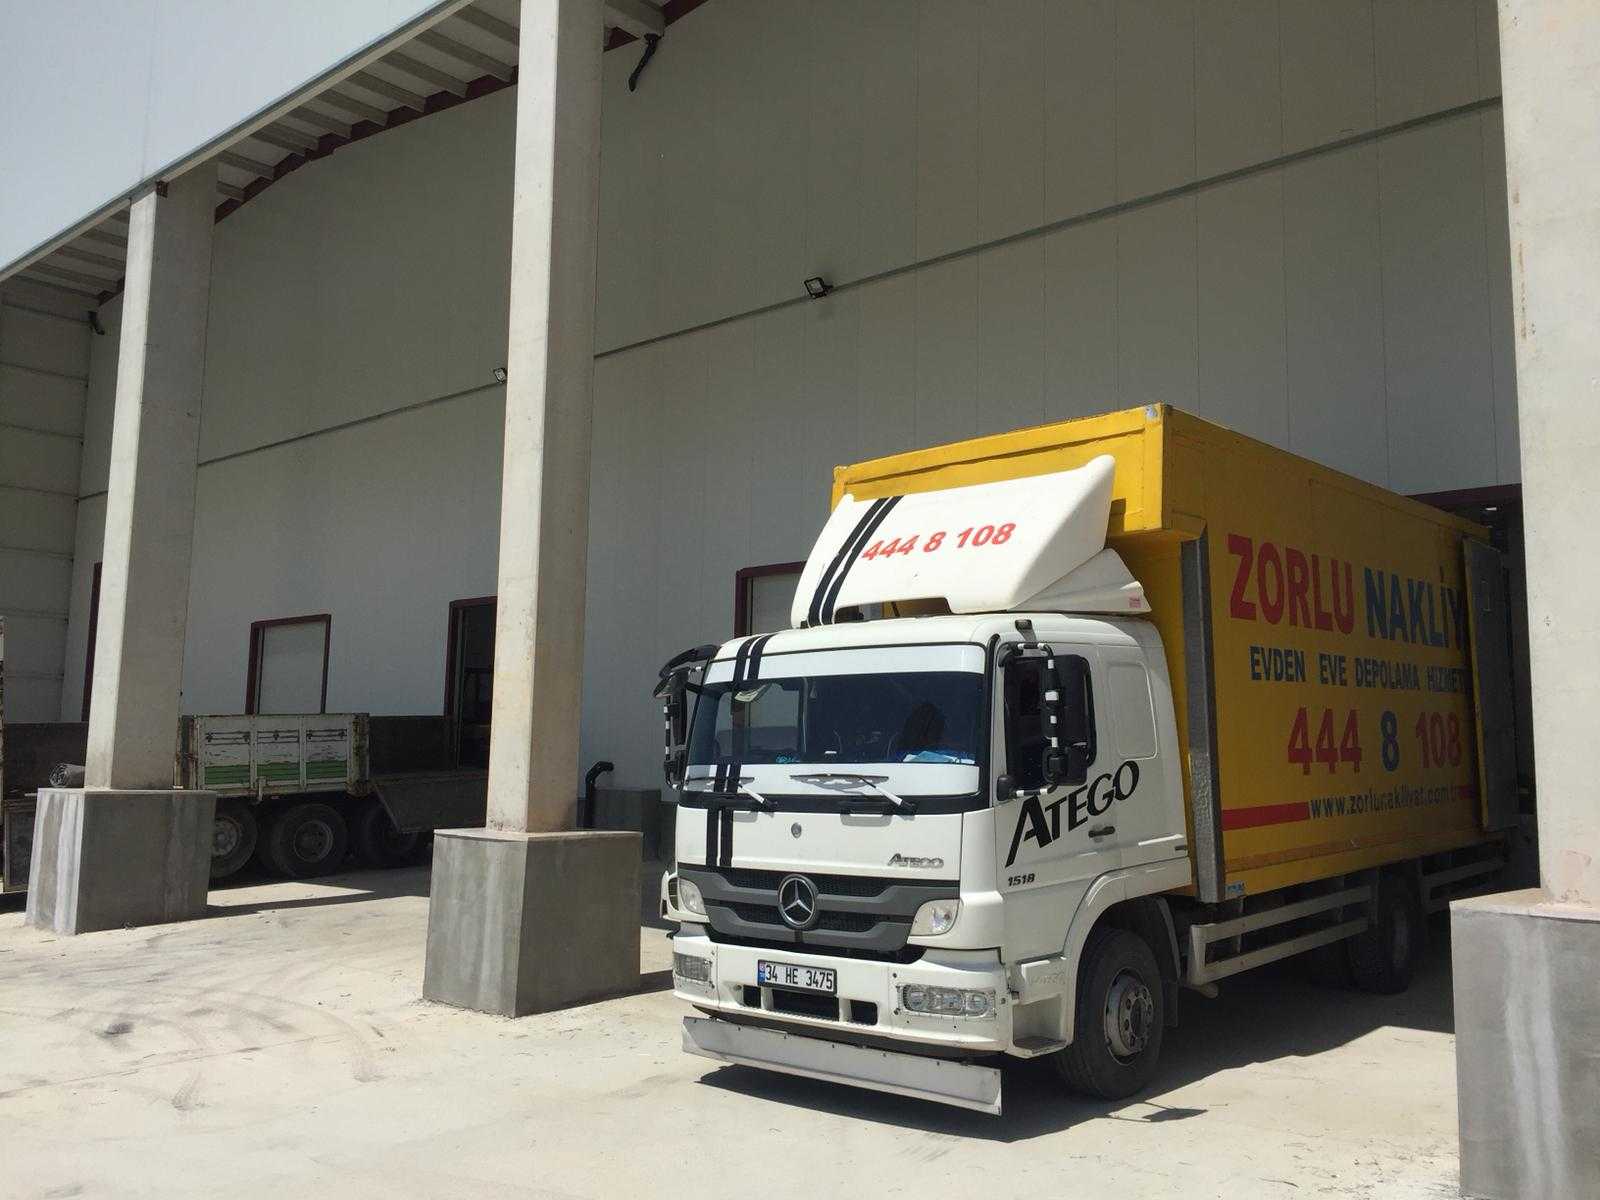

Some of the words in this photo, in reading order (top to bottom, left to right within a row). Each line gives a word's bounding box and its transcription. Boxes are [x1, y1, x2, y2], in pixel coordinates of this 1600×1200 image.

[862, 535, 920, 560] 444
[923, 531, 946, 552] 8
[957, 523, 1016, 548] 108
[1227, 533, 1355, 635] ZORLU
[1364, 566, 1464, 652] NAKLİY
[1249, 646, 1306, 682] EVDEN
[1319, 653, 1347, 686] EVE
[1355, 657, 1421, 691] DEPOLAMA
[1288, 706, 1362, 775] 444
[1380, 711, 1400, 772] 8
[1415, 711, 1463, 769] 108
[1005, 760, 1140, 868] ATEGO
[1007, 873, 1035, 887] 1518
[765, 964, 778, 982] 34
[785, 967, 799, 985] HE
[806, 970, 833, 990] 3475
